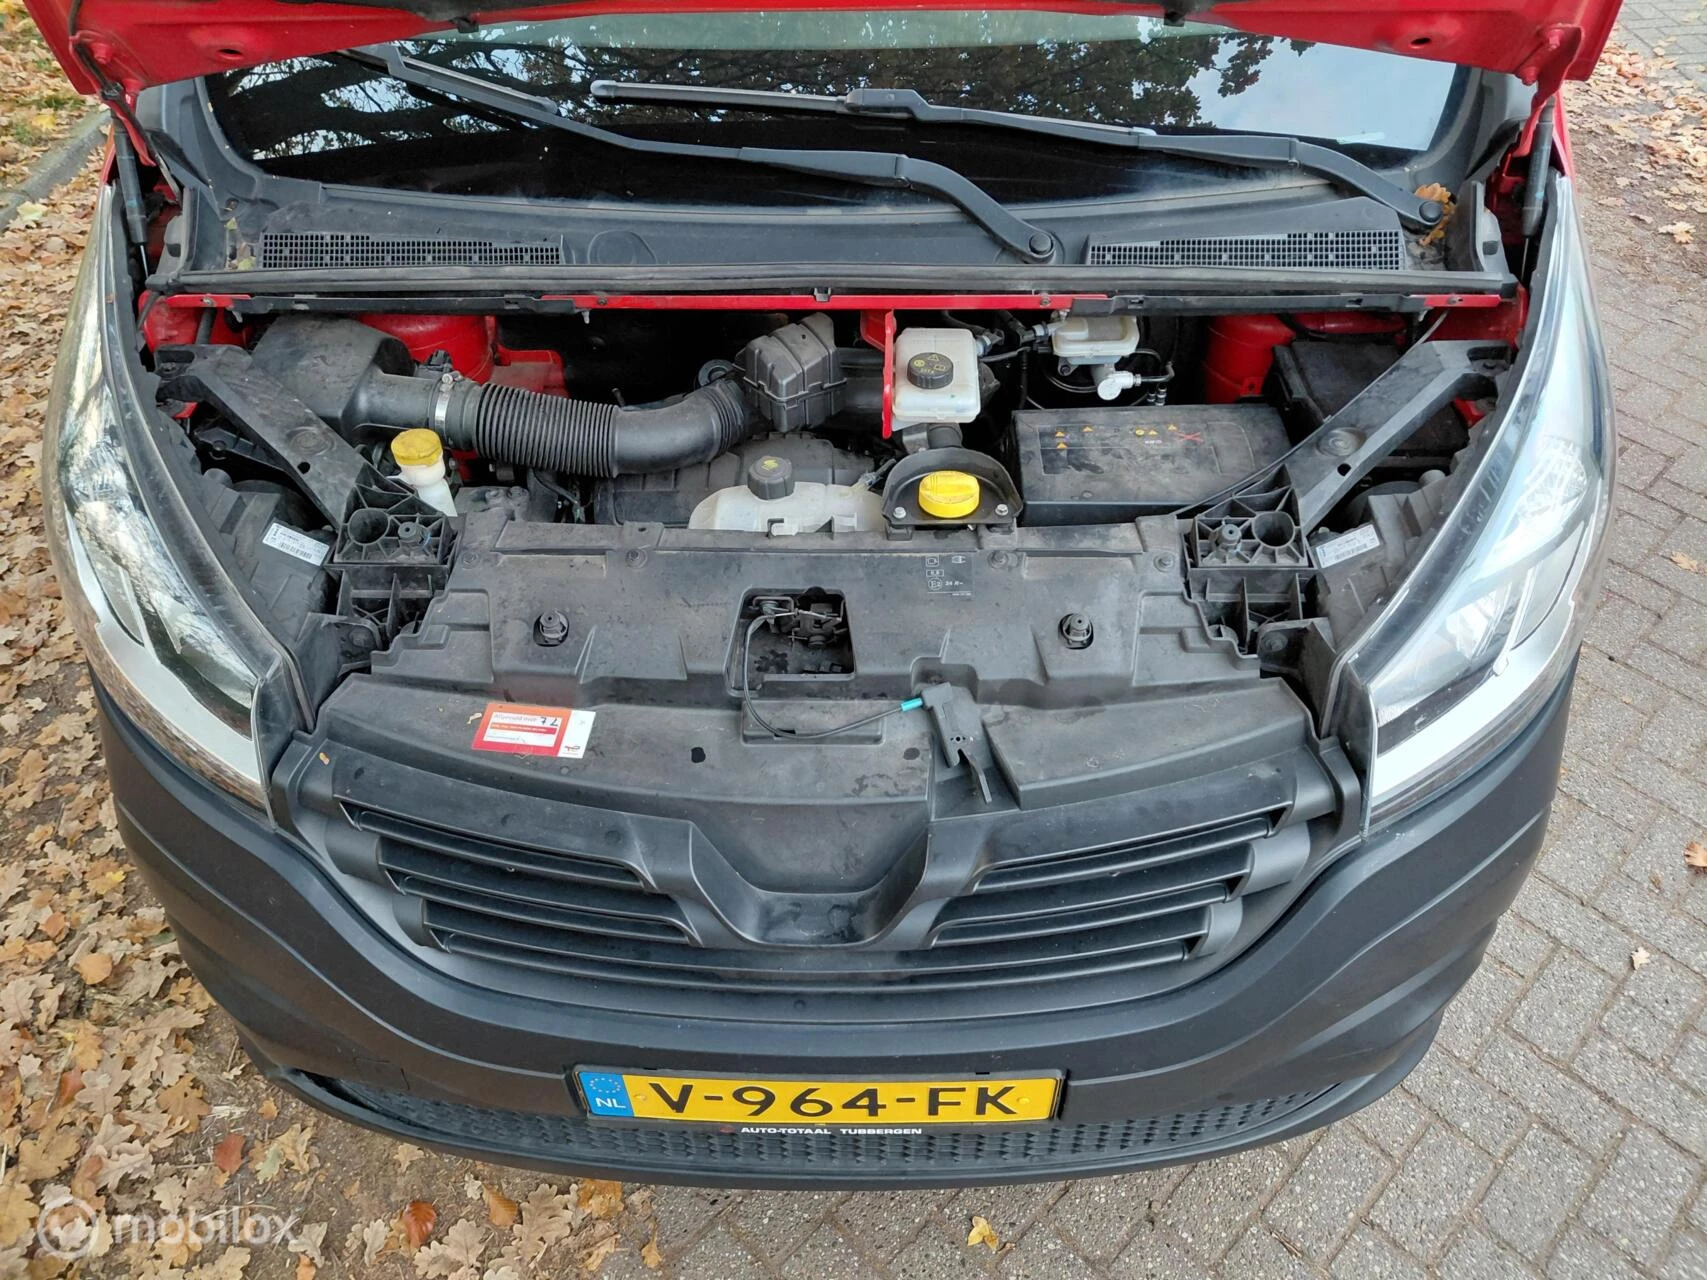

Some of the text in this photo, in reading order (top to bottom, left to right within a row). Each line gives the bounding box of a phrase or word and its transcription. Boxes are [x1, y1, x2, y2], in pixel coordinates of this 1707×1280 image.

[595, 1097, 626, 1109] NL
[648, 1082, 1017, 1117] V-964-FK
[740, 1126, 832, 1135] AUTO-TOTAAL
